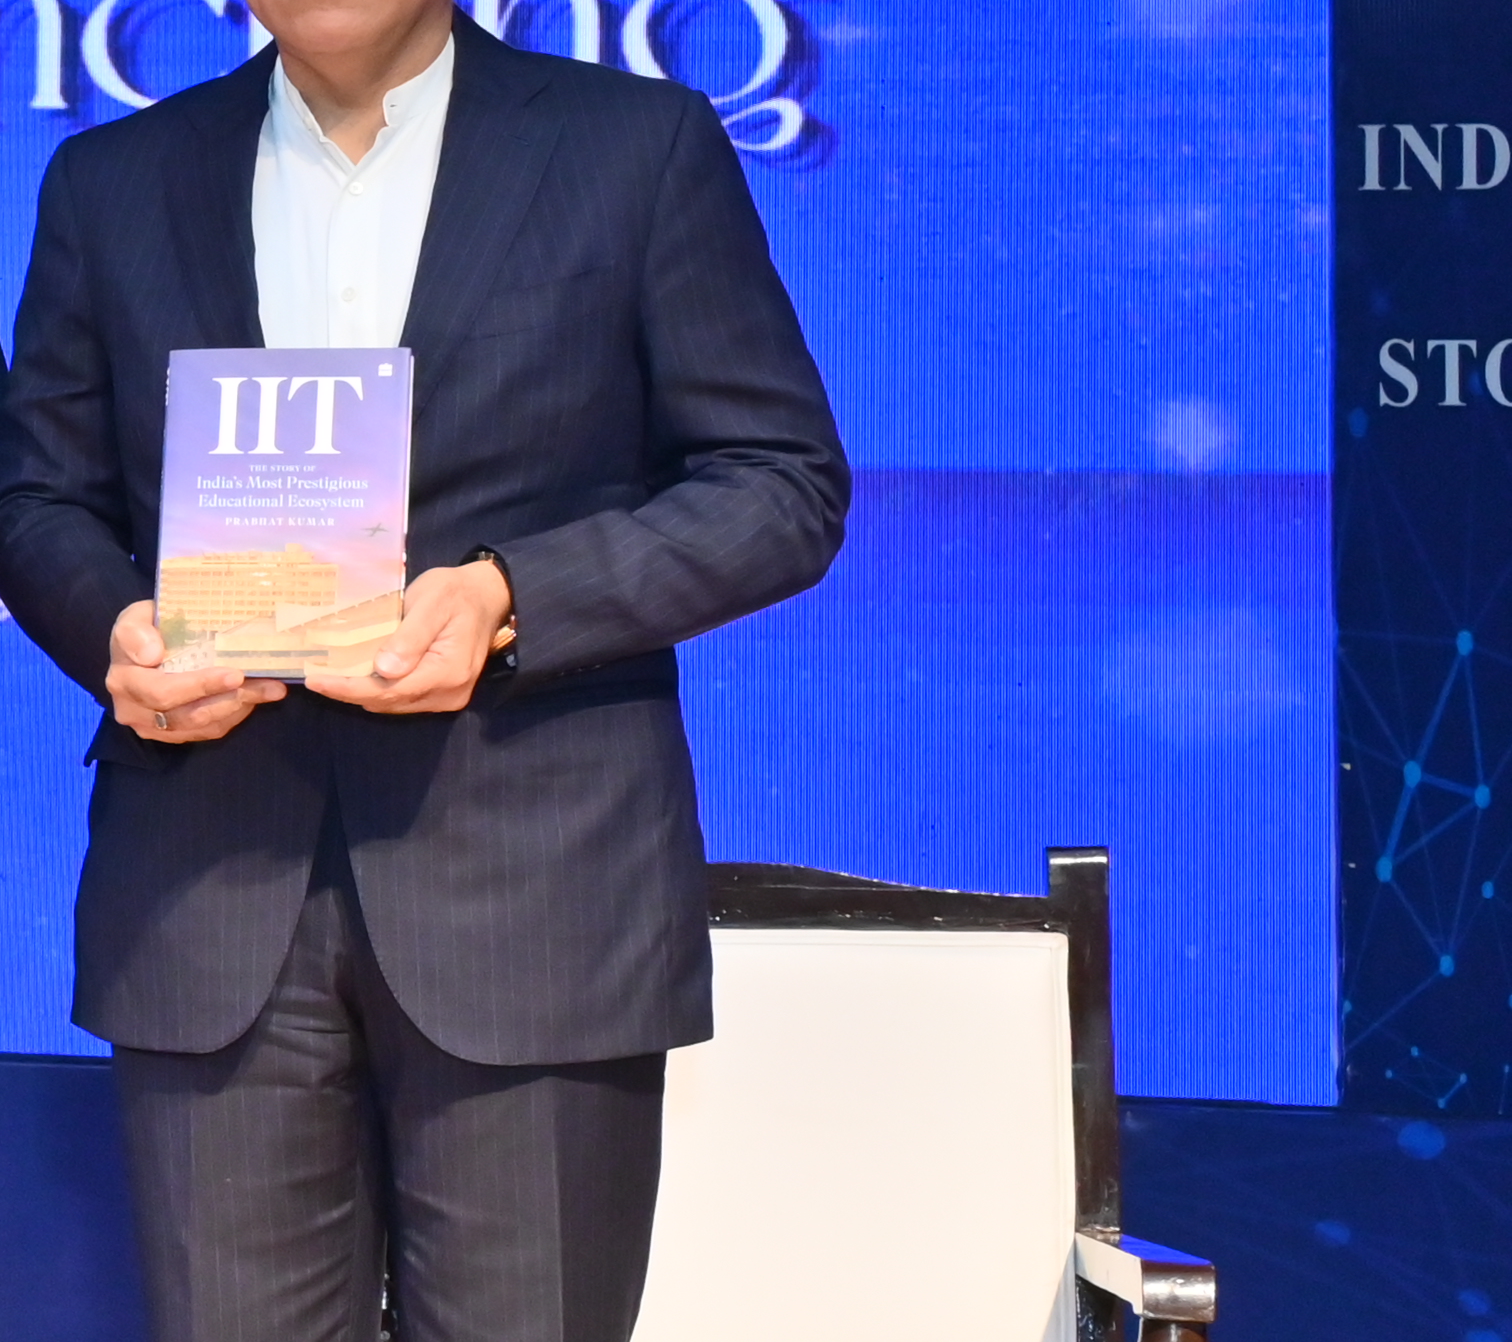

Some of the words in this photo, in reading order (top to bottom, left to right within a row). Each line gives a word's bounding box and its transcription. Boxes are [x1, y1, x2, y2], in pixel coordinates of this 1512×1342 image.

[208, 376, 363, 454] IIT
[246, 477, 282, 489] Most
[287, 476, 368, 492] Prestigious
[198, 494, 283, 508] Educational
[288, 495, 364, 510] Ecosystem
[225, 517, 283, 526] PRABHAT
[288, 518, 335, 526] KUMAR
